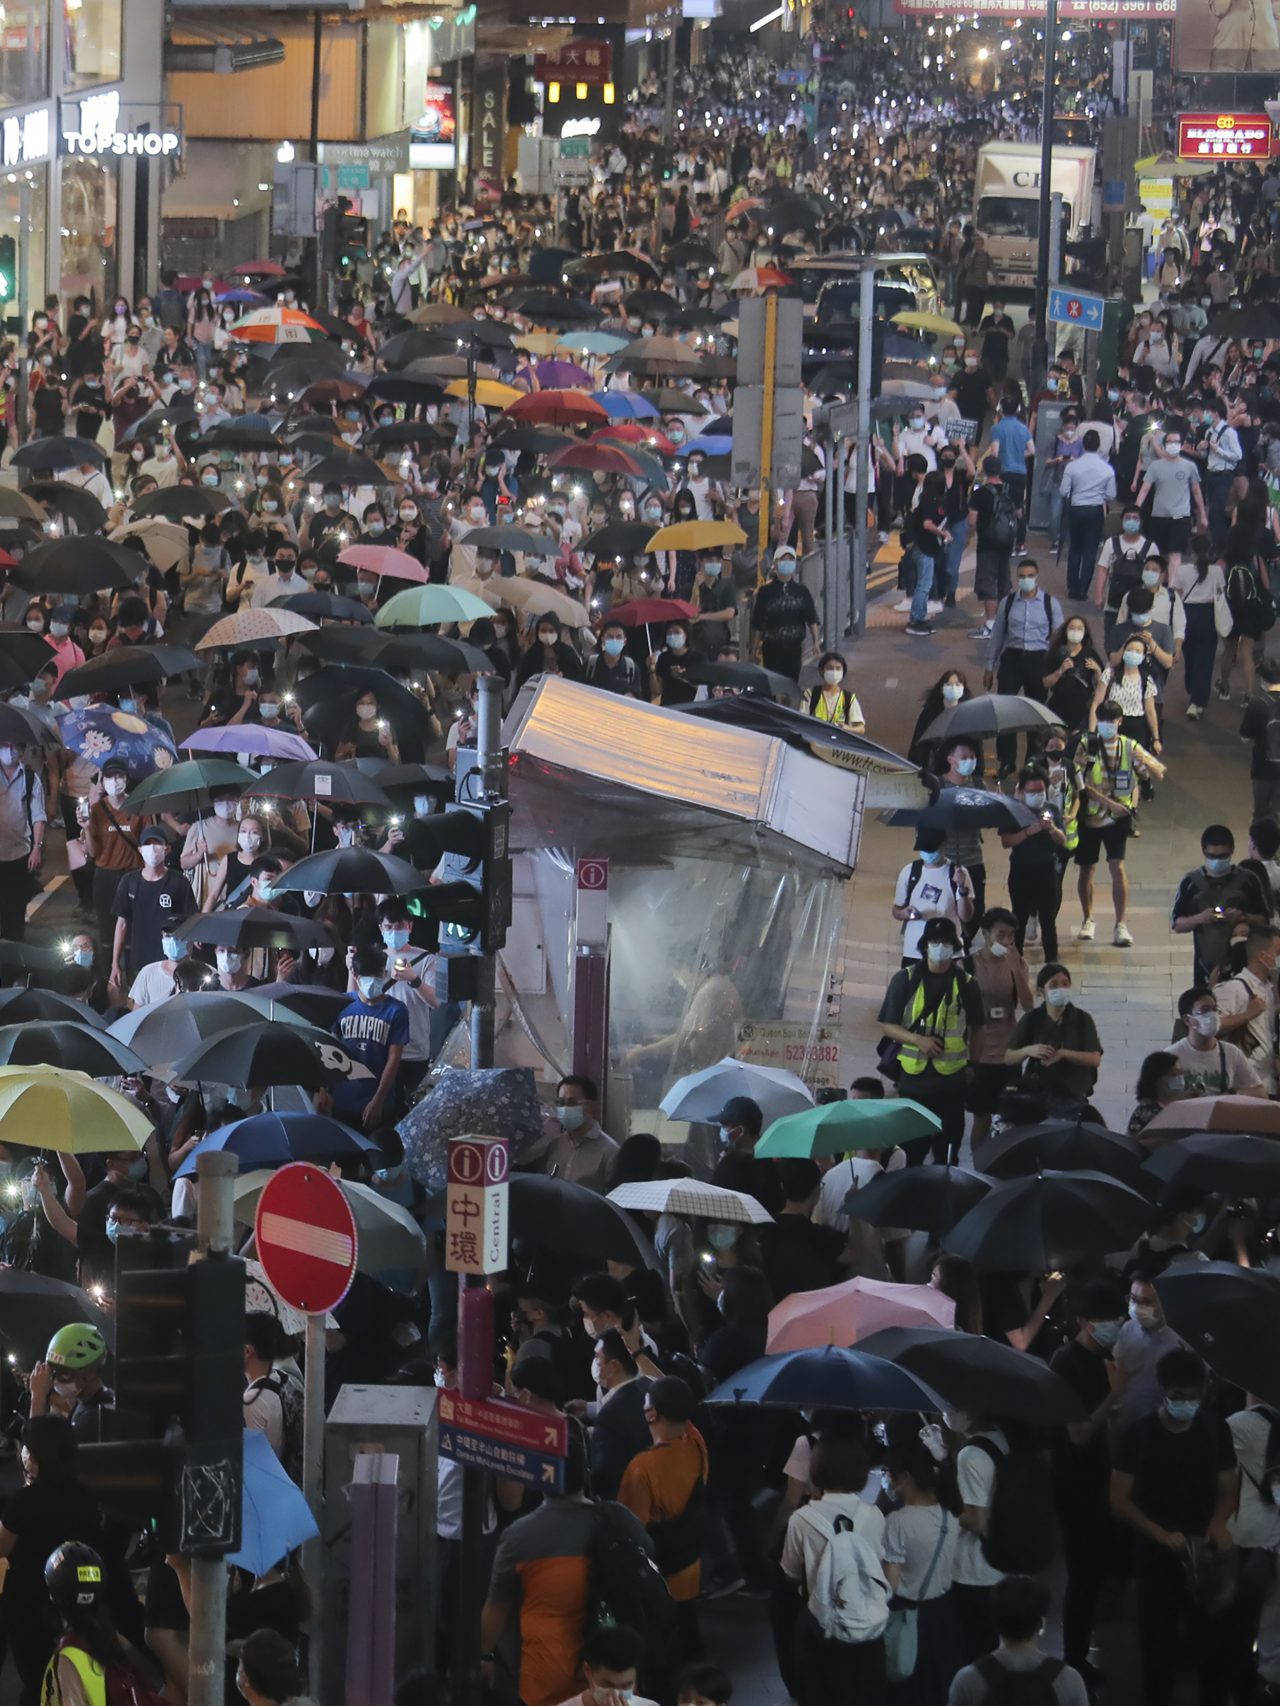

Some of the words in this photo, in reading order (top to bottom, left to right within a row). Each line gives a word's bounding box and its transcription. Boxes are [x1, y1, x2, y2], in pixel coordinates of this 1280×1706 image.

[63, 132, 178, 155] TOPSHOP
[482, 91, 496, 168] SALE
[340, 1014, 391, 1047] CHAMPION
[450, 1193, 480, 1266] 中環
[490, 1192, 501, 1263] Central
